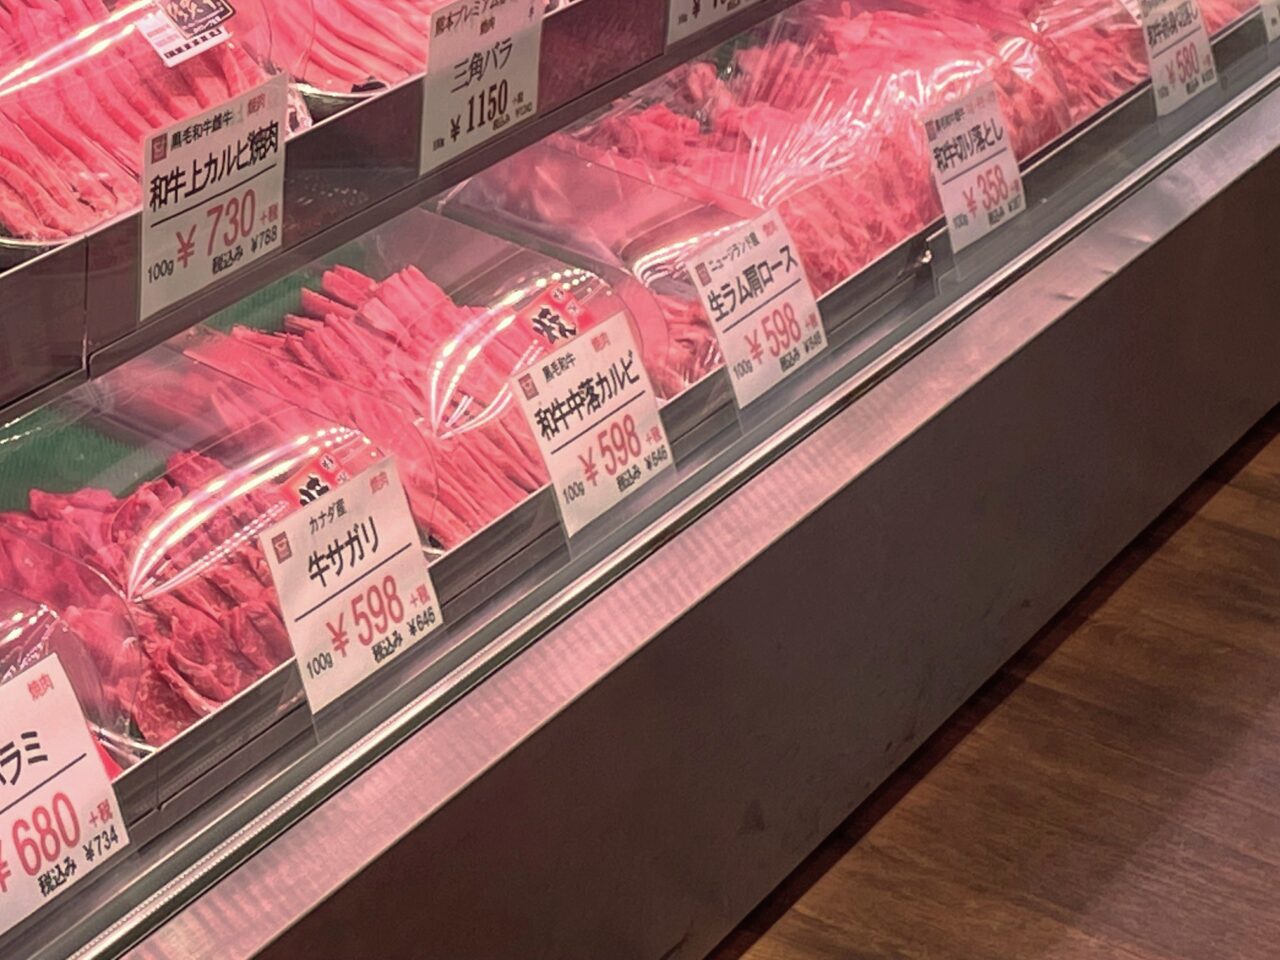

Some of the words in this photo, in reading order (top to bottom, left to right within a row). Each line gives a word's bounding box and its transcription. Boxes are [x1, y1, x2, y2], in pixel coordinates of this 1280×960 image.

[451, 37, 512, 93] 三角バラ
[450, 79, 508, 142] ¥1150
[963, 165, 1009, 219] ¥358
[148, 258, 174, 283] 100g
[176, 189, 255, 269] ¥730
[213, 243, 243, 275] 税込み
[707, 245, 798, 322] 生ラム肩ロース
[744, 302, 801, 365] ¥598
[534, 350, 640, 441] 和牛中落カルビ
[542, 352, 576, 382] 黒毛和牛
[563, 480, 585, 504] 100g
[578, 414, 641, 487] ¥598
[309, 498, 348, 534] カナダ産
[308, 516, 379, 587] 牛サガリ
[307, 652, 333, 679] 100g
[327, 575, 404, 657] ¥598
[371, 631, 403, 663] 税込み
[38, 856, 77, 897] 税込み
[82, 825, 118, 862] ¥734
